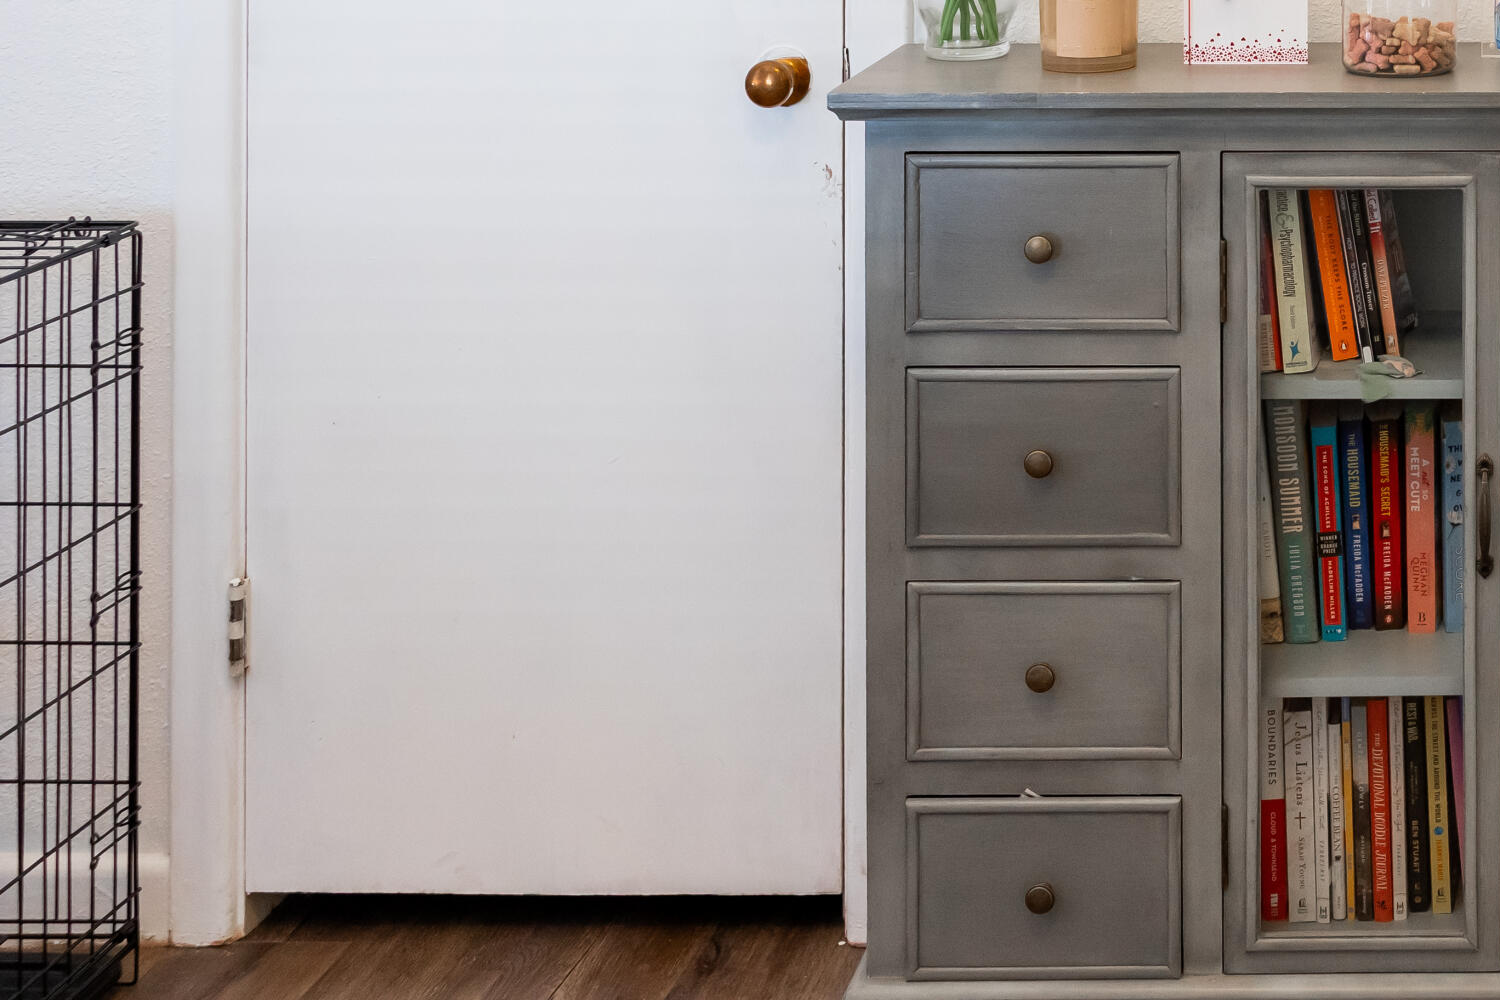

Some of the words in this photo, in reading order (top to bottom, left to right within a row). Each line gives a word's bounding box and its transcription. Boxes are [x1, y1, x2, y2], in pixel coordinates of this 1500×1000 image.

[1326, 216, 1334, 230] THE
[1353, 213, 1362, 236] Storm
[1278, 229, 1297, 298] Psychopharmacology
[1332, 257, 1342, 283] KEEPS
[1336, 286, 1344, 301] THE
[1338, 304, 1348, 332] SCORE
[1273, 406, 1298, 473] MONSOON
[1347, 433, 1356, 447] THE
[1379, 430, 1391, 483] HOUSEMAID'S
[1410, 446, 1420, 477] MEET
[1422, 459, 1430, 467] A
[1323, 486, 1330, 495] OF
[1346, 448, 1361, 508] HOUSEMAID
[1279, 477, 1304, 535] SUMMER
[1380, 486, 1392, 517] SECRET
[1410, 480, 1421, 513] CUTE
[1323, 497, 1331, 529] ACHILLES
[1288, 544, 1302, 571] JULIA
[1352, 535, 1362, 561] FREIDA
[1383, 541, 1392, 568] FREIDA
[1327, 560, 1335, 594] MADELINE
[1354, 563, 1365, 603] McFADDEN
[1410, 556, 1420, 593] QUINN
[1419, 552, 1429, 597] MEGHAN
[1290, 574, 1306, 618] GREGSON
[1383, 571, 1394, 610] McFADDEN
[1328, 595, 1336, 620] MILLER
[1407, 702, 1418, 720] REST
[1267, 709, 1278, 785] BOUNDARIES
[1294, 721, 1308, 756] Jesus
[1374, 733, 1382, 747] THE
[1295, 761, 1309, 807] Listens
[1371, 747, 1386, 809] DEVOTIONAL
[1433, 766, 1441, 790] AROUND
[1332, 785, 1343, 824] COFFEE
[1434, 803, 1442, 823] WORLD
[1270, 811, 1278, 835] CLOUD
[1333, 824, 1343, 852] BEAN
[1374, 811, 1387, 849] DOODLE
[1411, 819, 1421, 838] BEN
[1271, 844, 1279, 882] TOWNSEND
[1298, 835, 1306, 861] SARAH
[1412, 839, 1422, 873] STUART
[1299, 862, 1307, 889] YOUNG
[1375, 850, 1389, 893] JOURNAL
